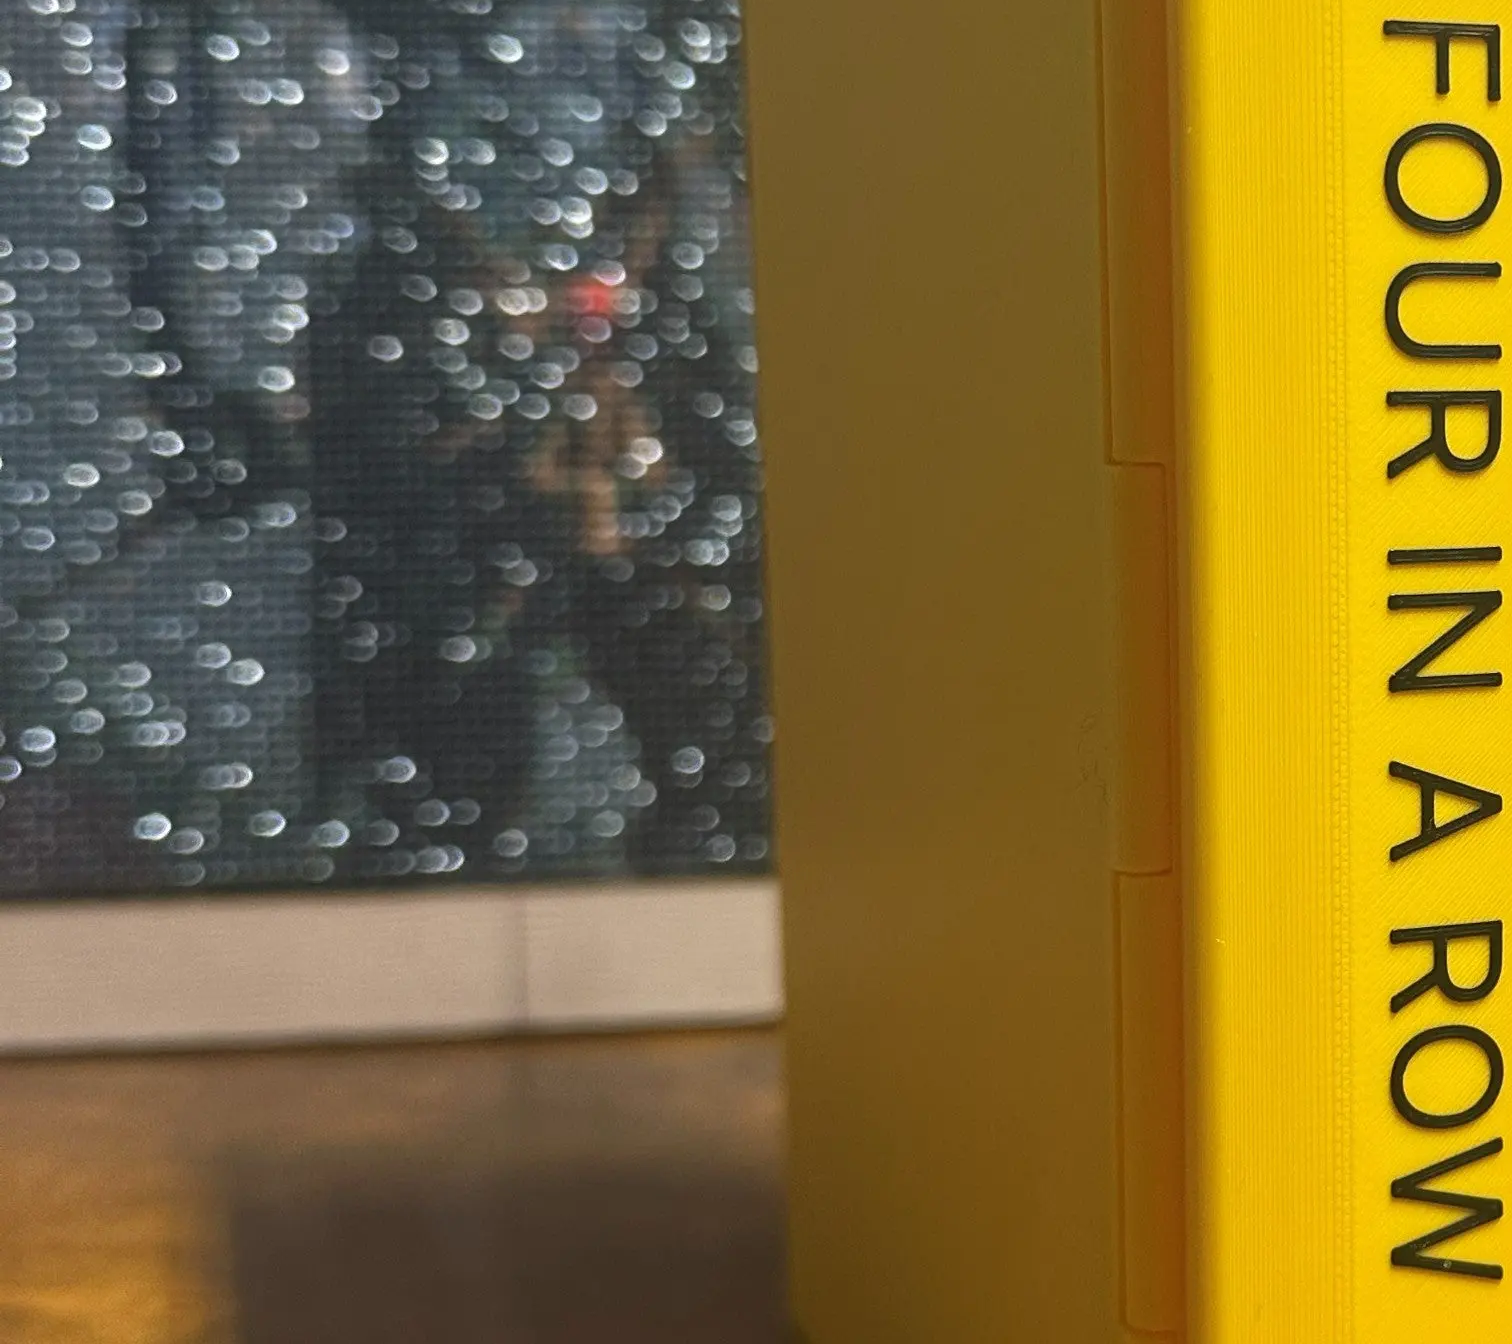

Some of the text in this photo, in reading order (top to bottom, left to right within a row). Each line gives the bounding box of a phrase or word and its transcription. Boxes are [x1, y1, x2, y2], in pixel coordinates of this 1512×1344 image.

[1383, 19, 1504, 1281] FOUR IN A ROW
